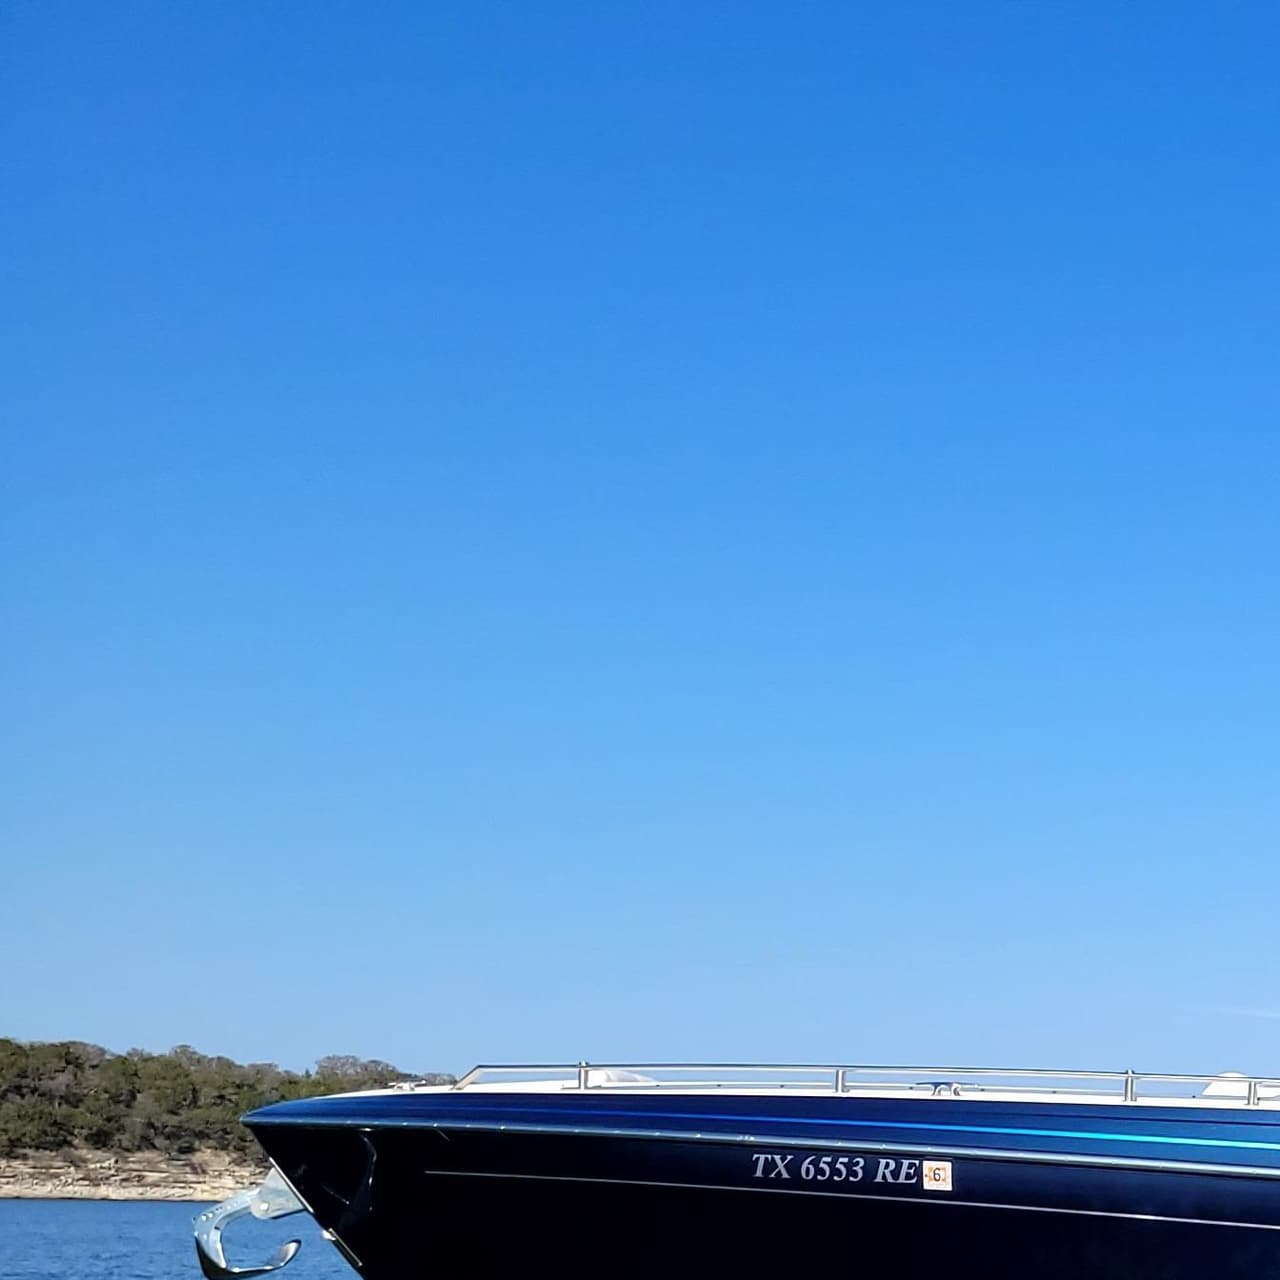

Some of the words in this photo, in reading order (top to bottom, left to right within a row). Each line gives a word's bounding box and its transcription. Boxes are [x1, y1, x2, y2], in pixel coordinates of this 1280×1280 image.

[752, 1154, 794, 1180] TX
[800, 1155, 865, 1182] 6553
[874, 1158, 920, 1184] RE
